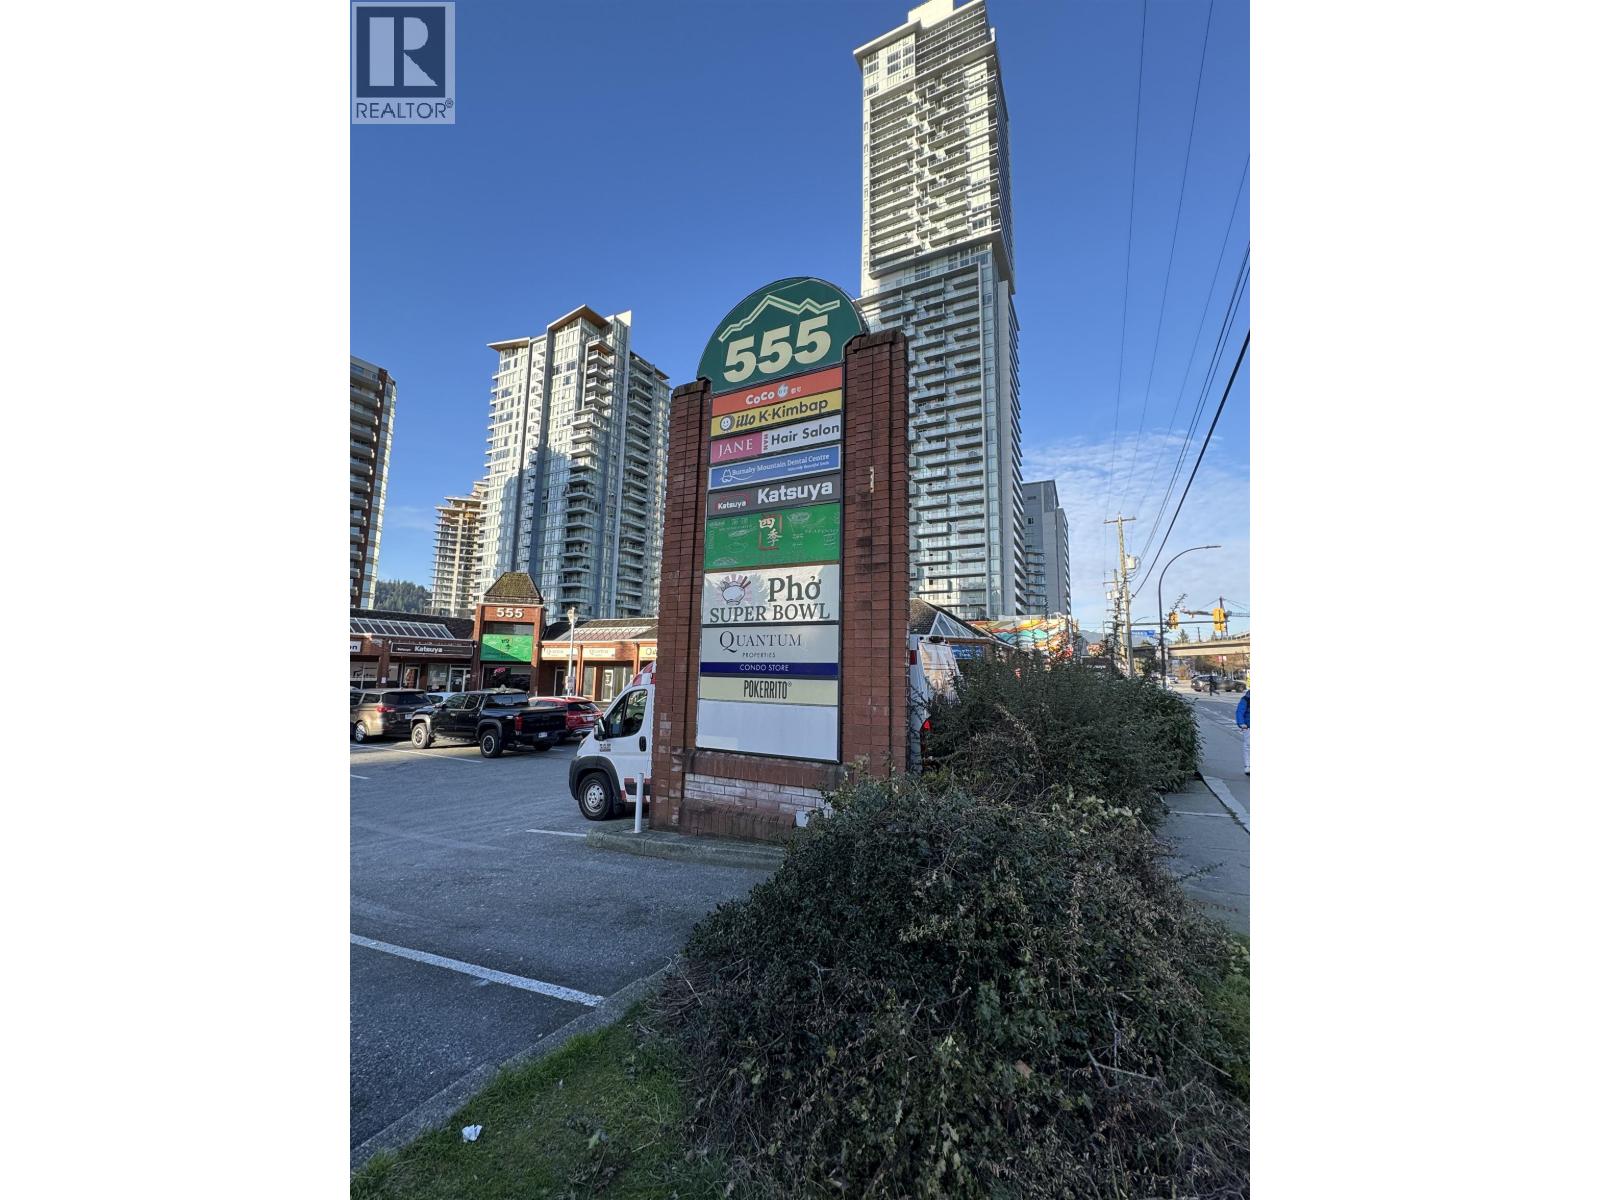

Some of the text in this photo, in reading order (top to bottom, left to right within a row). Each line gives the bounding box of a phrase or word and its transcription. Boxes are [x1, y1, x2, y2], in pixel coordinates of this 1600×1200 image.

[723, 314, 831, 383] 555
[745, 390, 775, 405] CoCo
[760, 399, 828, 423] K-Kimbap
[771, 424, 840, 446] Hair Salon
[718, 438, 753, 458] JANE
[731, 466, 756, 476] Burnaby
[756, 461, 787, 472] Mountain
[787, 456, 808, 466] Dental
[808, 454, 830, 463] Centre
[757, 481, 833, 505] Katsuya
[718, 500, 747, 510] Katsuya
[760, 518, 783, 547] 四季
[767, 575, 822, 603] Phở
[496, 607, 524, 619] 555
[710, 603, 831, 623] SUPER BOWL
[414, 645, 443, 654] Katsuya
[719, 630, 802, 653] QUANTUM
[768, 664, 790, 672] STORE
